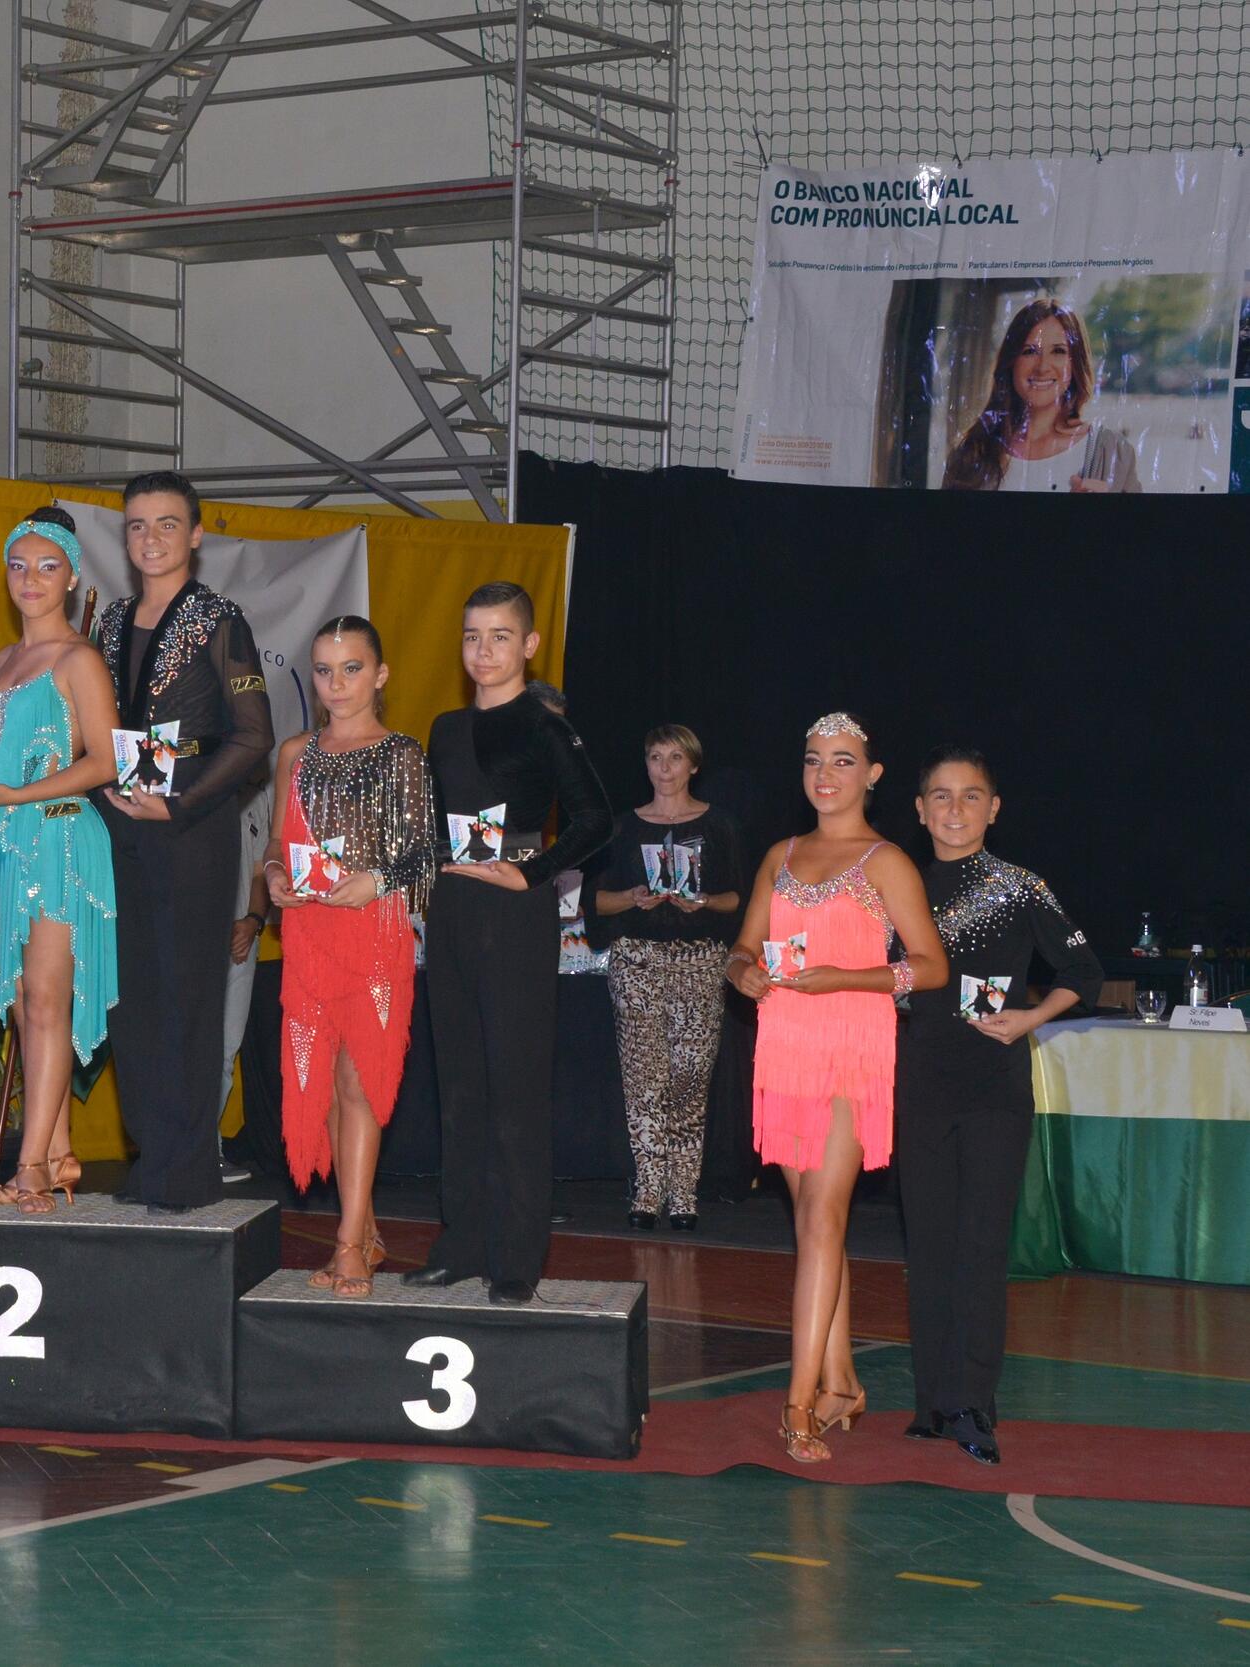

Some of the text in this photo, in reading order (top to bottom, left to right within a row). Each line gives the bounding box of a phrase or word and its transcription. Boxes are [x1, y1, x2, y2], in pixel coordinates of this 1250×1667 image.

[774, 180, 790, 200] O
[794, 181, 859, 204] BANCO
[770, 200, 1019, 228] COM PRONÚNCIA LOCAL
[829, 263, 852, 272] Crédito
[1013, 261, 1047, 269] Empresas
[1088, 259, 1121, 268] Pequenos
[402, 1336, 477, 1431] 3
